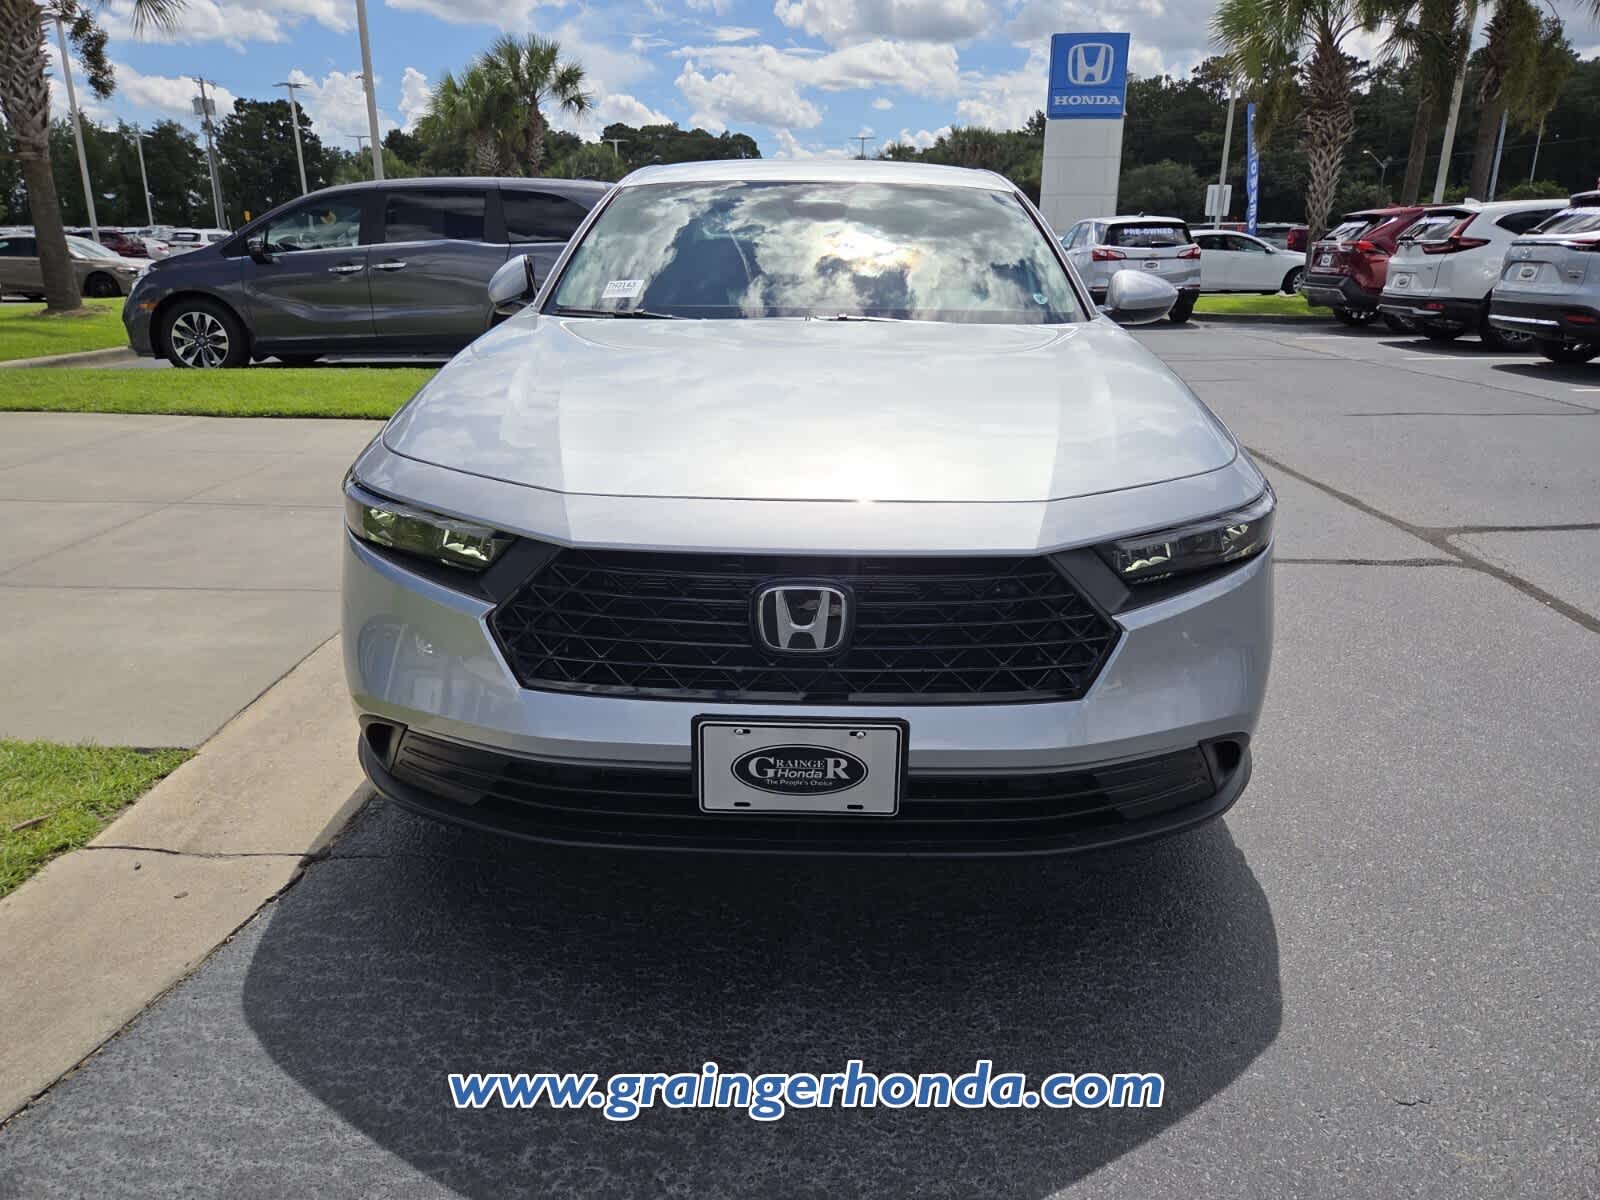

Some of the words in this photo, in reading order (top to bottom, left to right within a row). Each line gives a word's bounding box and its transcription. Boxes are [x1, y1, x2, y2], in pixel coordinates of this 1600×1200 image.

[1054, 95, 1121, 105] HONDA
[1123, 227, 1174, 235] PRE-OWNED
[748, 756, 850, 779] GRAINGER
[777, 769, 822, 778] Honda
